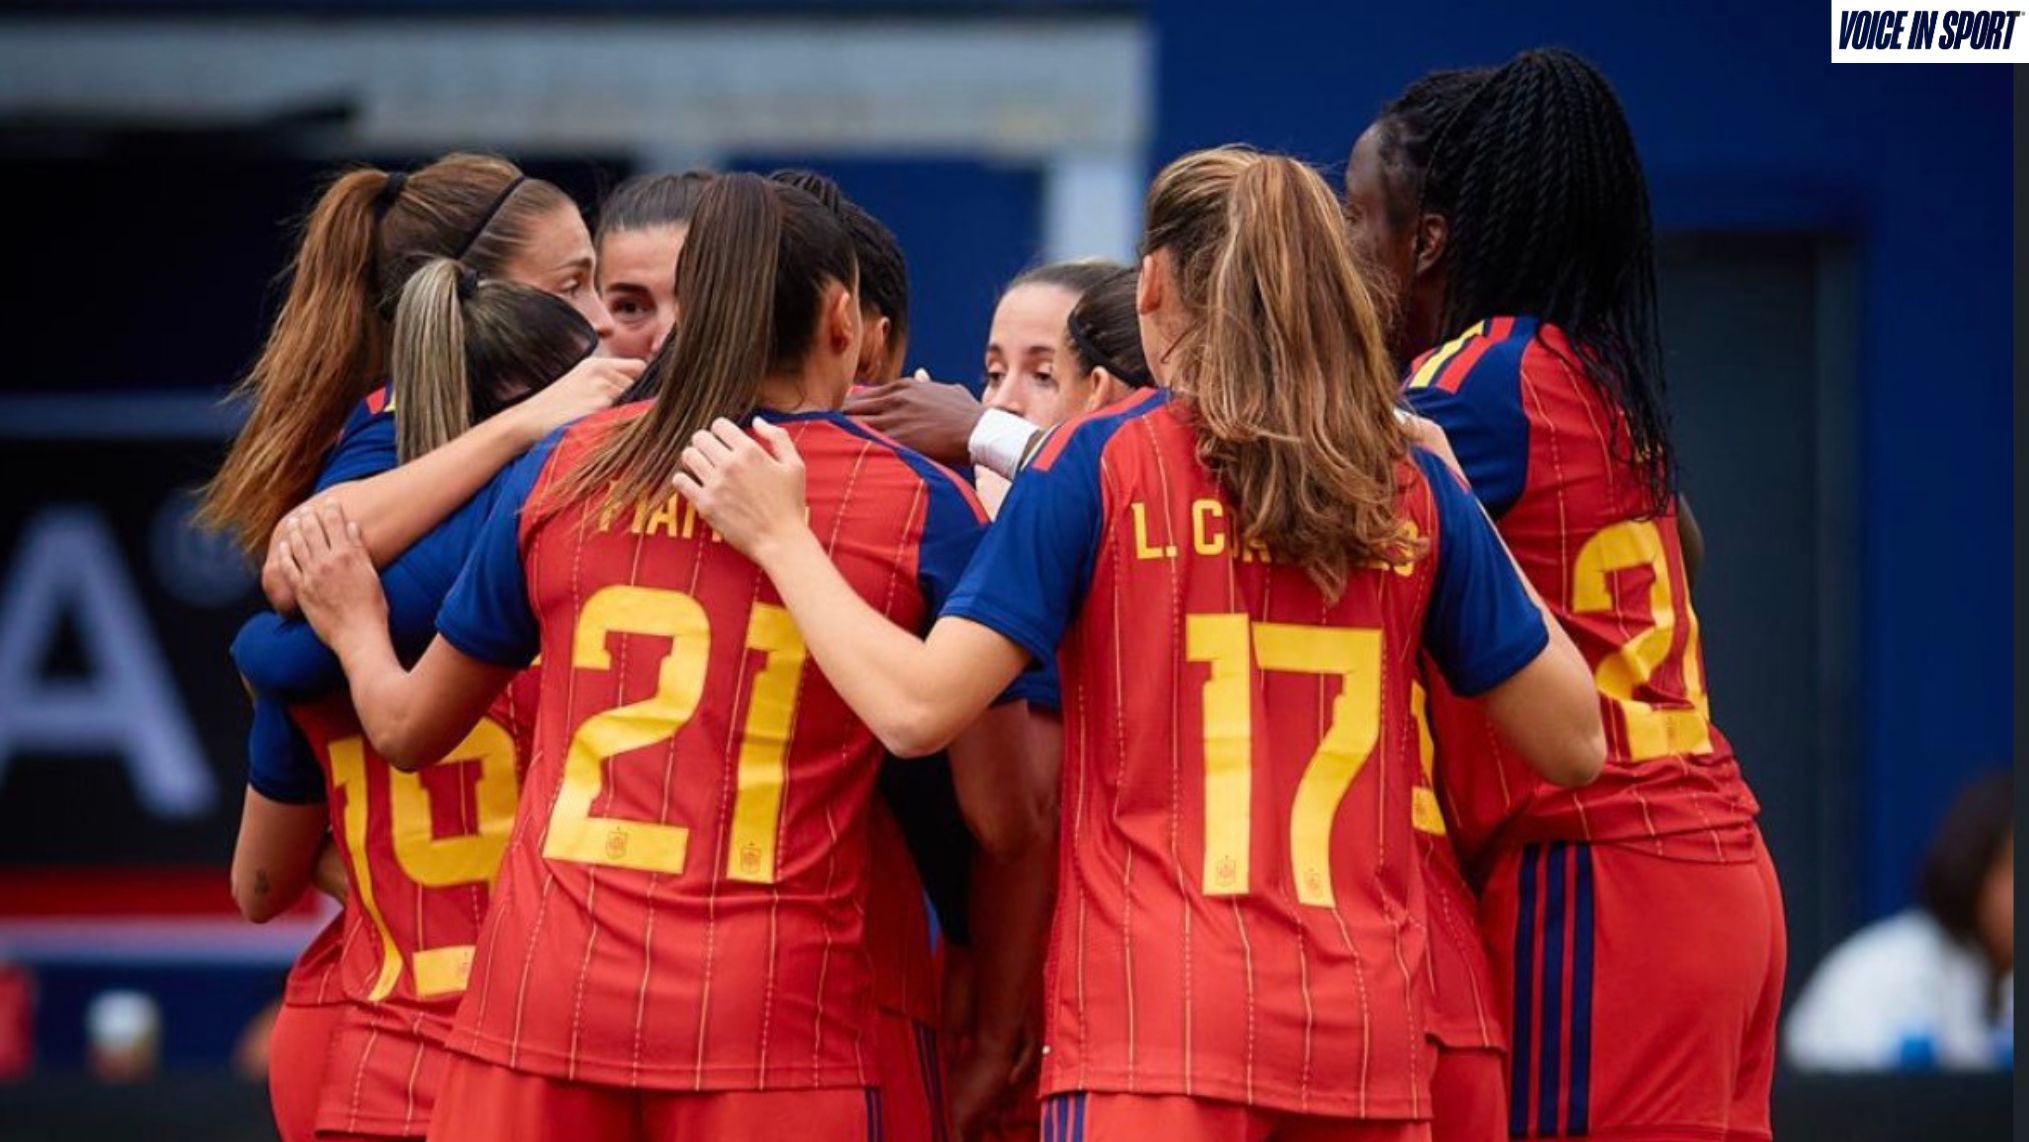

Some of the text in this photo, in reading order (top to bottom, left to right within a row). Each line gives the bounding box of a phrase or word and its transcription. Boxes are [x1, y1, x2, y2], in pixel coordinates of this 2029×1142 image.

[1131, 502, 1178, 559] L.
[328, 717, 518, 1001] 19
[543, 585, 806, 883] 21
[1185, 612, 1382, 908] 17
